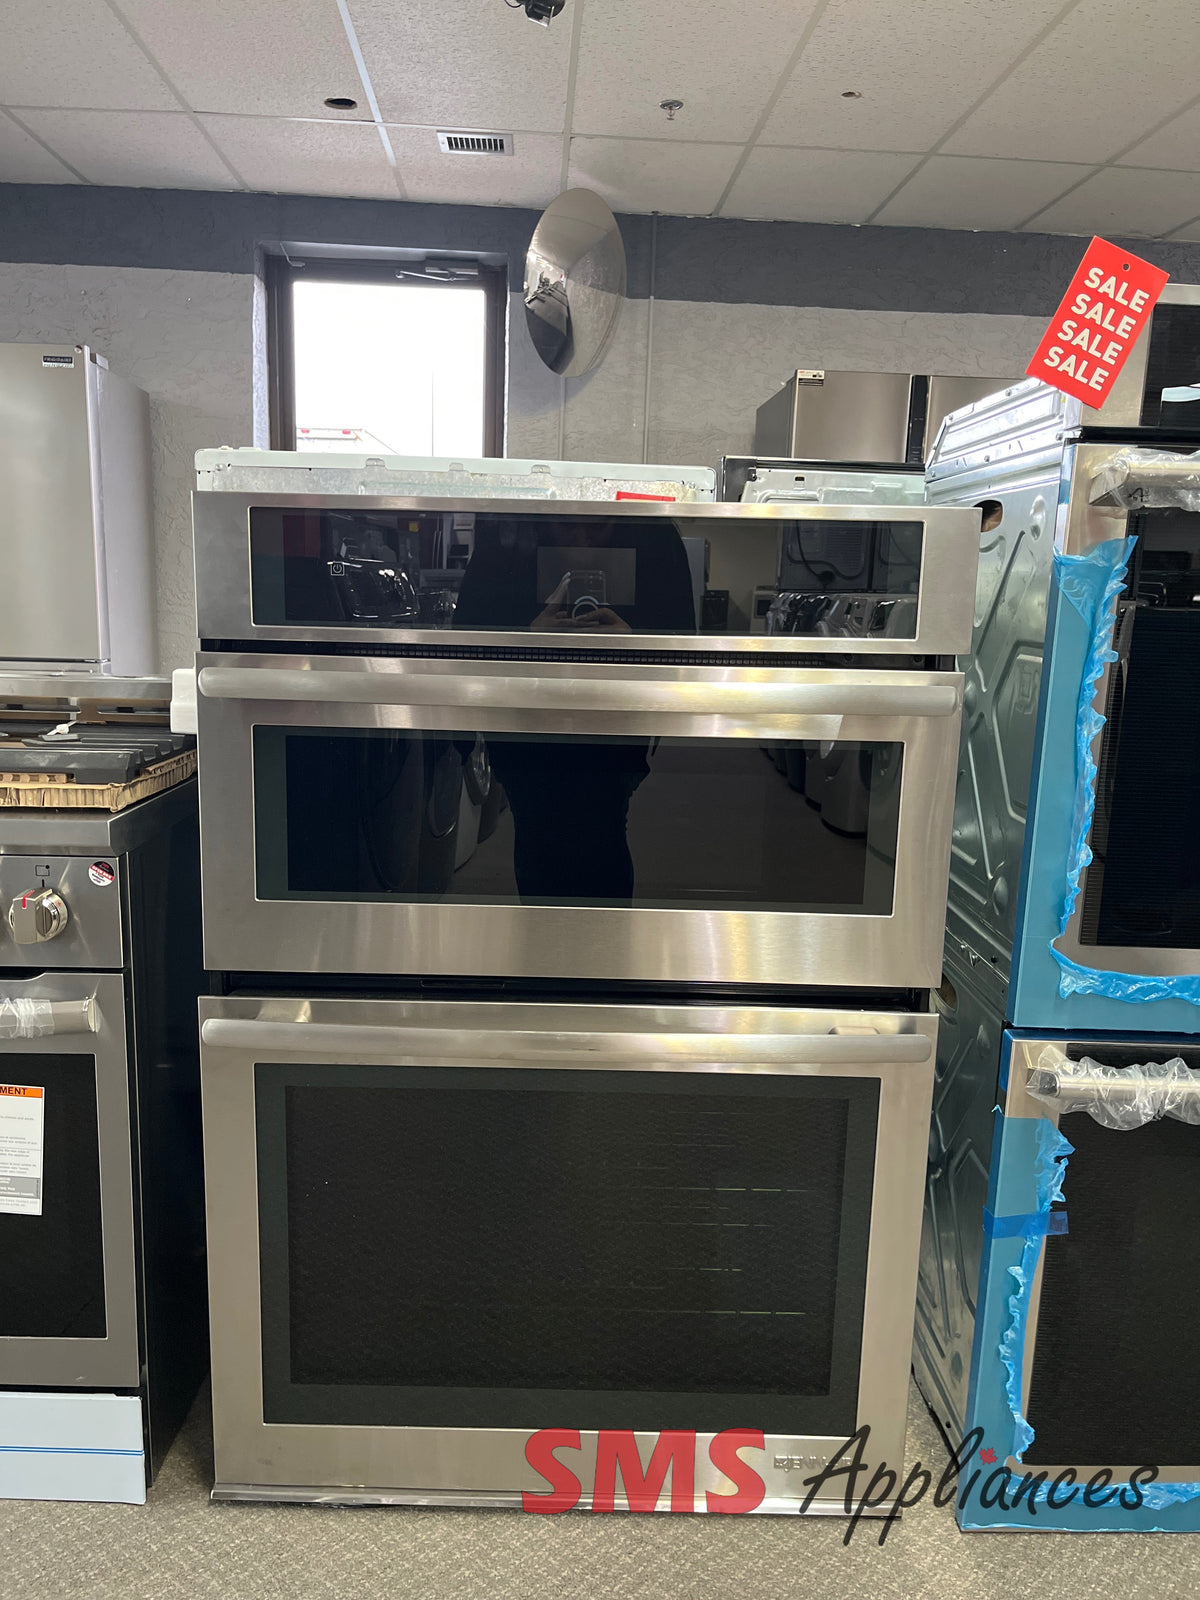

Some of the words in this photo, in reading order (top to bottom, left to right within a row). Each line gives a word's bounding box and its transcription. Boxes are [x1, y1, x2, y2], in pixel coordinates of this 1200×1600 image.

[1084, 267, 1149, 313] SALE
[1071, 294, 1136, 339] SALE
[1057, 320, 1123, 365] SALE
[1044, 346, 1109, 391] SALE
